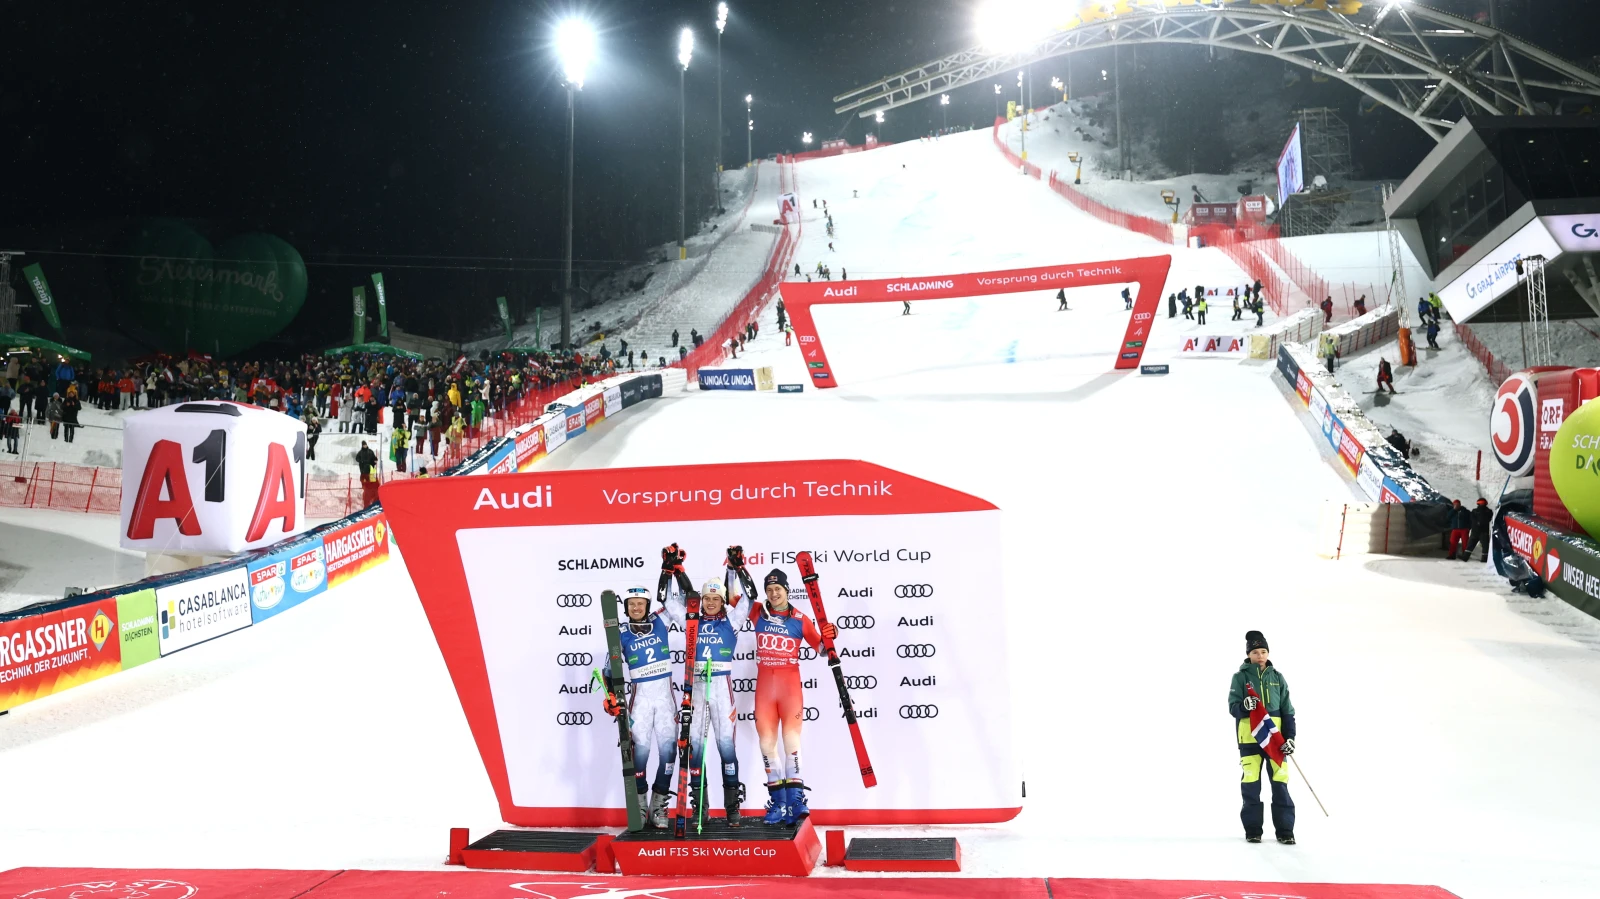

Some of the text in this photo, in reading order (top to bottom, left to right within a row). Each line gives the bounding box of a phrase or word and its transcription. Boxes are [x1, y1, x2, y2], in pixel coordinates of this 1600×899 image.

[137, 254, 284, 302] Steiermark
[824, 266, 1122, 297] Audi SCHLADMING Vorsprung durch Technik
[1477, 274, 1494, 293] GRAZ
[1226, 287, 1239, 296] A1
[1183, 337, 1199, 352] A1
[1205, 337, 1221, 352] A1
[1228, 337, 1244, 352] A1
[704, 375, 753, 386] UNIQA UNIQA
[568, 416, 581, 429] SPAR
[1543, 406, 1561, 425] ORF
[127, 429, 228, 541] A1
[245, 431, 306, 543] A1
[473, 480, 893, 511] Audi Vorsprung durch Technik
[325, 525, 375, 563] HARGASSNER
[297, 551, 317, 568] SPAR
[558, 557, 644, 571] SCHLADMING
[771, 551, 796, 565] FIS
[834, 549, 890, 563] World
[896, 548, 931, 563] Cup
[256, 565, 277, 582] SPAR
[1563, 562, 1584, 591] UNSER
[178, 582, 247, 616] CASABLANCA
[838, 587, 873, 598] Audi
[121, 615, 154, 632] SCHLADMING
[179, 602, 248, 633] hotelsoftware
[898, 616, 934, 627] Audi
[558, 625, 592, 635] Audi
[764, 626, 789, 635] UNIQA
[630, 636, 662, 651] UNIQA
[688, 624, 696, 660] ROSSIGNOL
[645, 648, 657, 663] 2
[702, 646, 712, 660] 4
[839, 647, 875, 658] Audi
[34, 657, 54, 674] DER
[638, 661, 667, 674] SCHLADMING
[900, 676, 936, 687] Audi
[558, 684, 592, 695] Audi
[861, 766, 874, 776] GS
[637, 847, 777, 858] Audi FIS Ski World Cup
